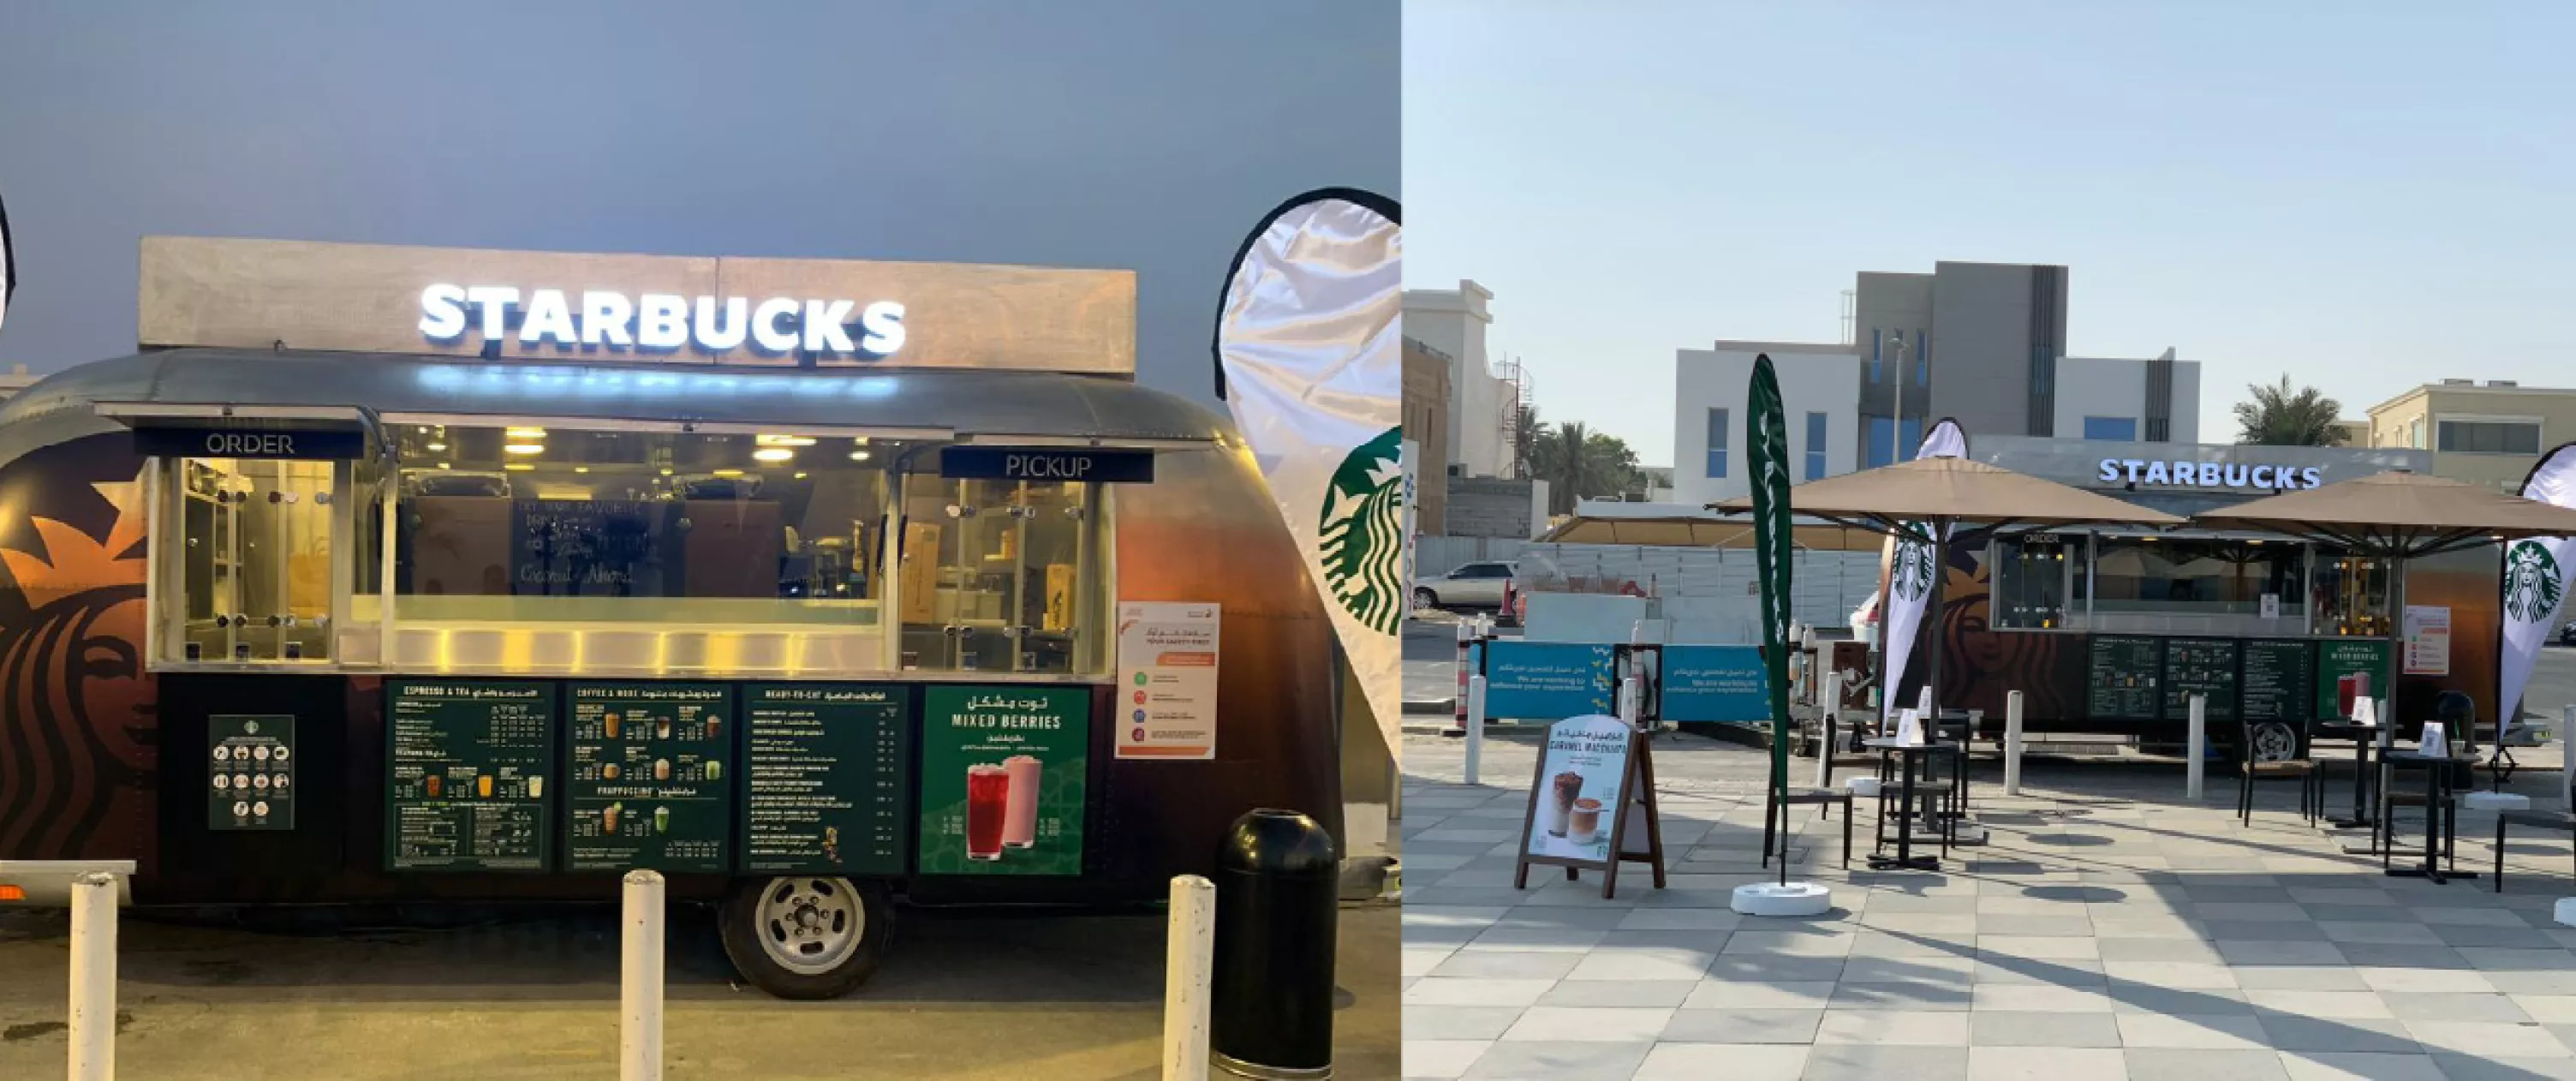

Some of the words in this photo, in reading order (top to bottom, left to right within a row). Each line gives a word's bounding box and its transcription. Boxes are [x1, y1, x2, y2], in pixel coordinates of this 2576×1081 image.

[418, 283, 906, 355] STARBUCKS
[206, 432, 295, 455] ORDER
[1005, 454, 1093, 478] PICKUP
[2098, 458, 2321, 491] STARBUCKS
[967, 694, 1016, 710] مشكل
[1017, 696, 1048, 711] توت
[951, 714, 996, 728] MIXED
[1001, 714, 1062, 730] BERRIES
